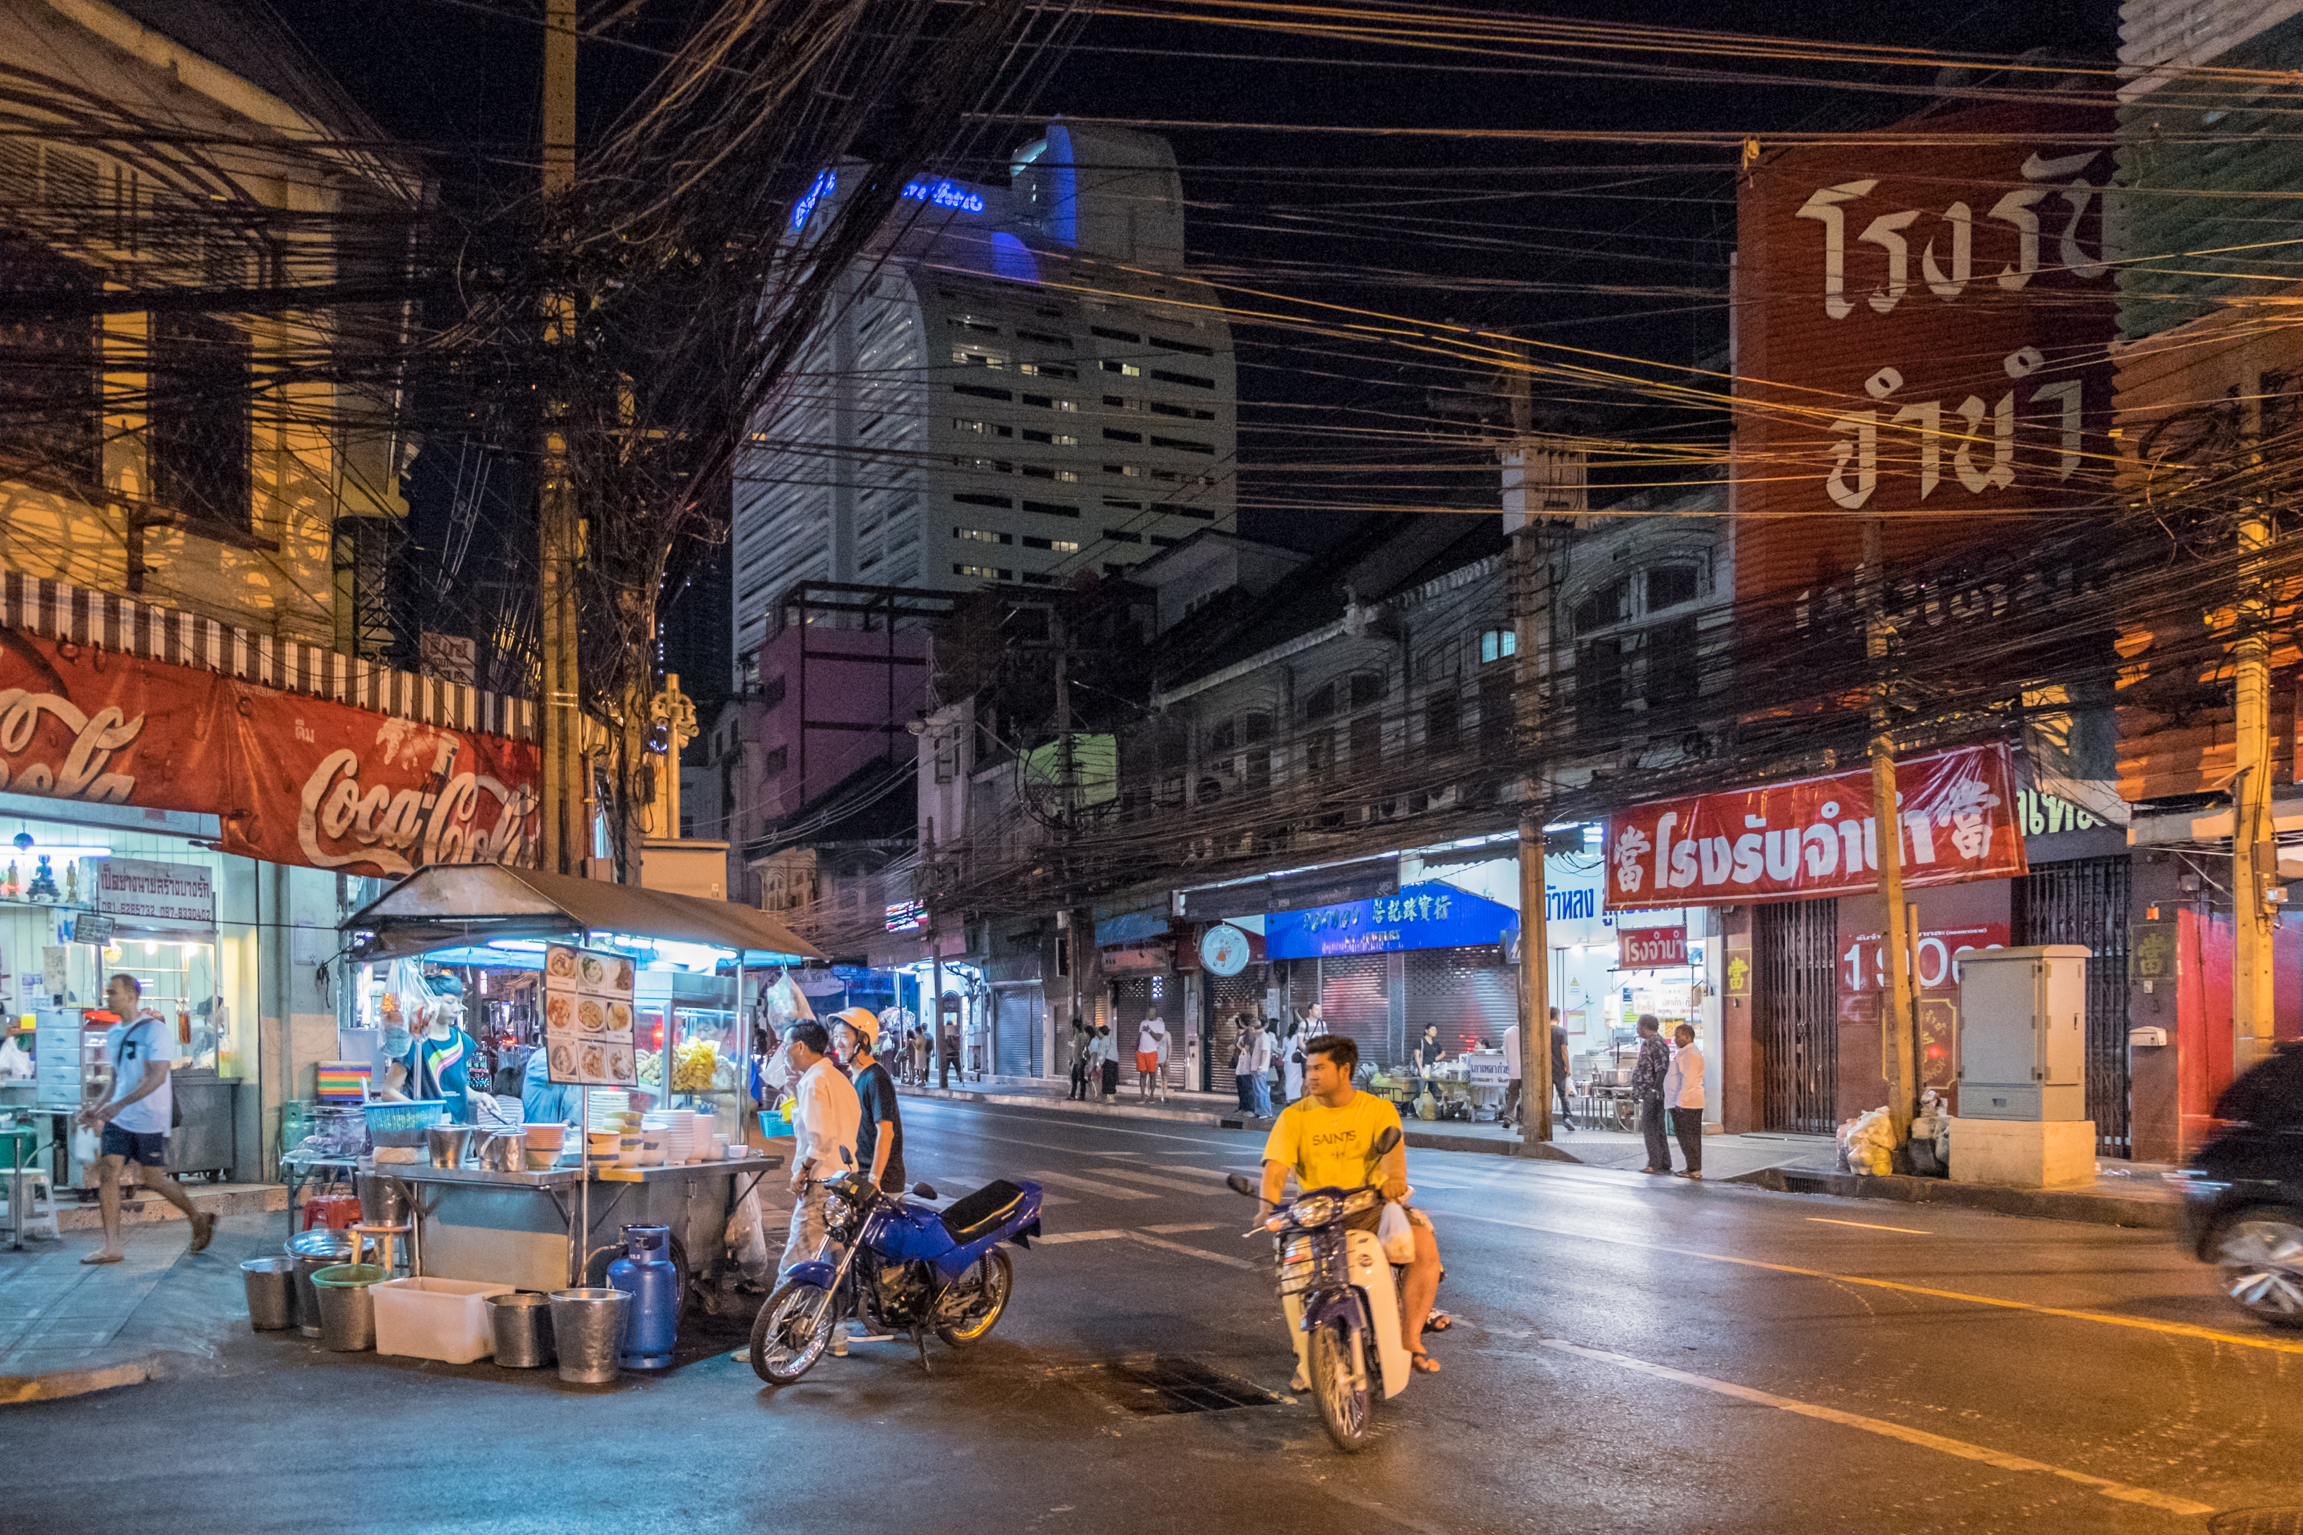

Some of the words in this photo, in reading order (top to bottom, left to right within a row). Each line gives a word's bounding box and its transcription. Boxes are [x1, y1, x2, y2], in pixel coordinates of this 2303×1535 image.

[1826, 346, 2083, 510] จำนำ
[1624, 929, 1684, 963] โรงจำนำ
[1727, 957, 1749, 990] 當
[1313, 1130, 1356, 1146] SAINTS
